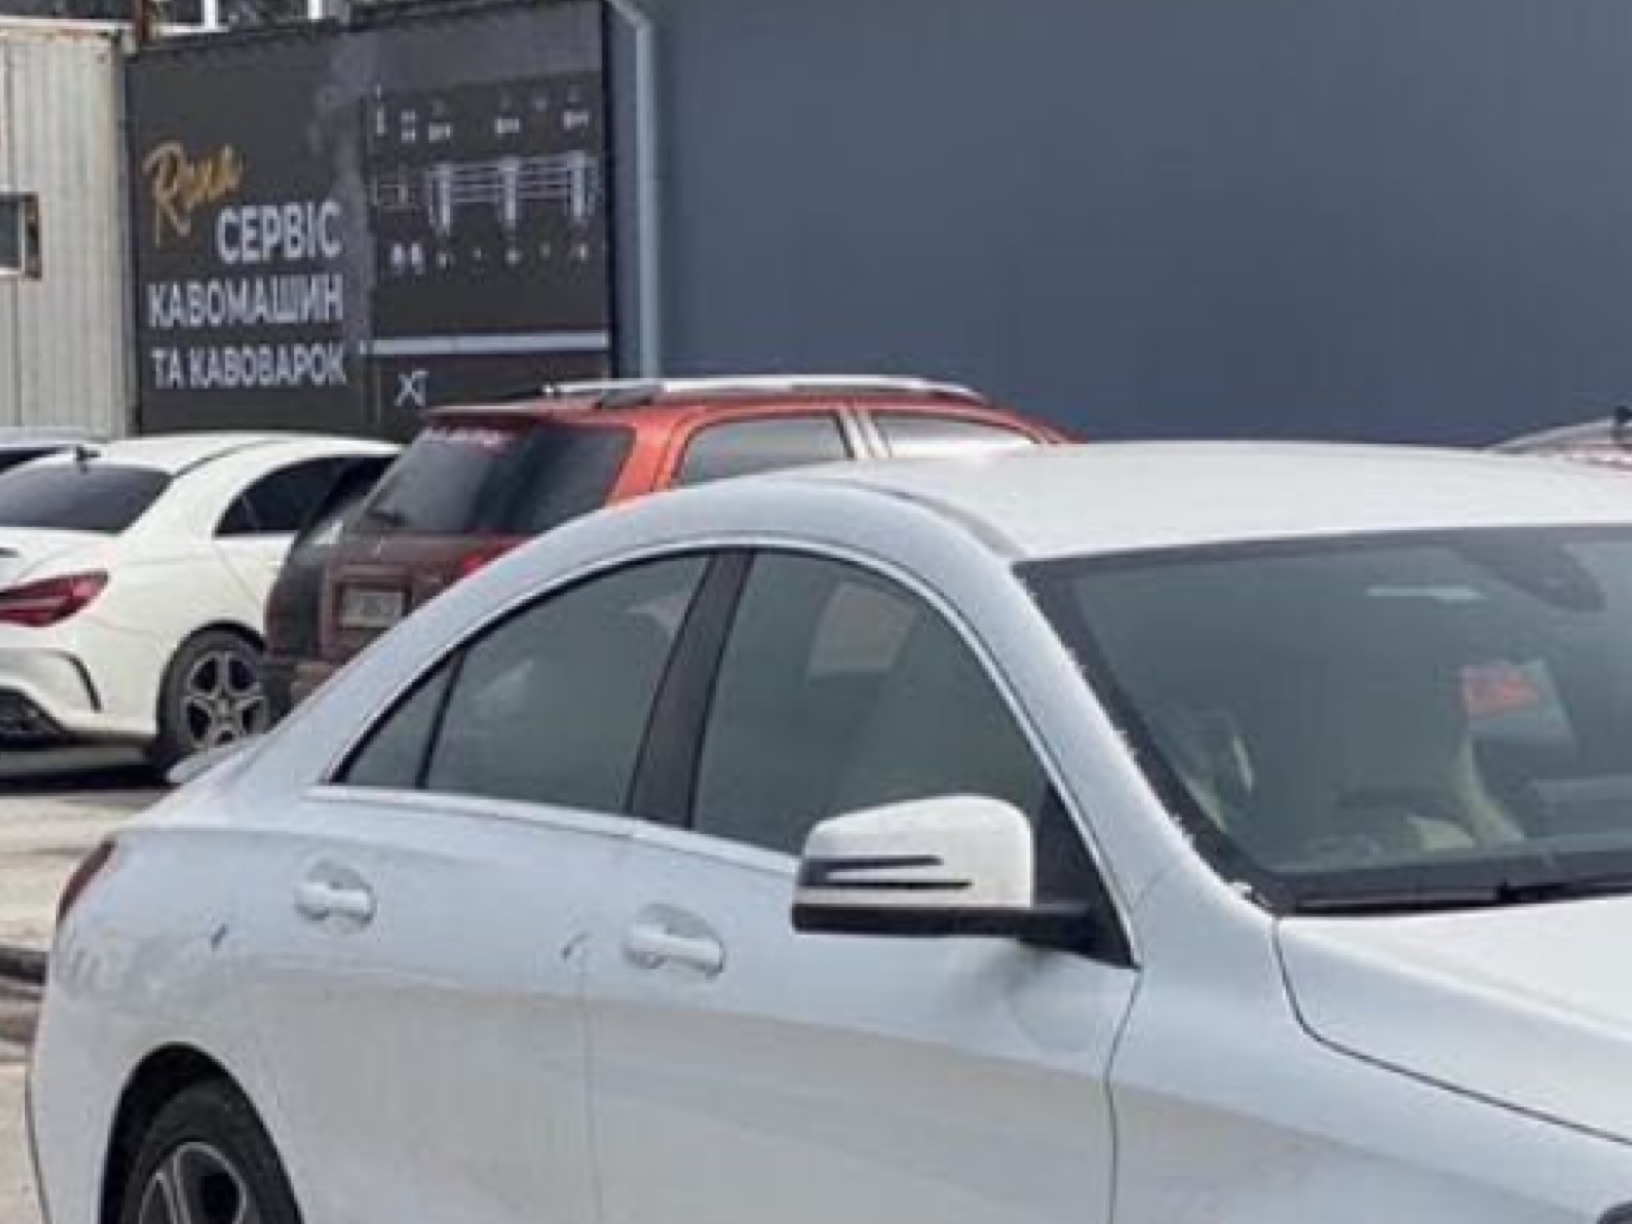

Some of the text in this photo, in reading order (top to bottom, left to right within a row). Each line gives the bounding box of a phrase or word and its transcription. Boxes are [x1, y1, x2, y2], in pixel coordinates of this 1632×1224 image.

[217, 200, 342, 264] СЕРВІС
[148, 273, 343, 327] КАВОМАШИН
[152, 342, 347, 389] ТА КАВОВАРОК
